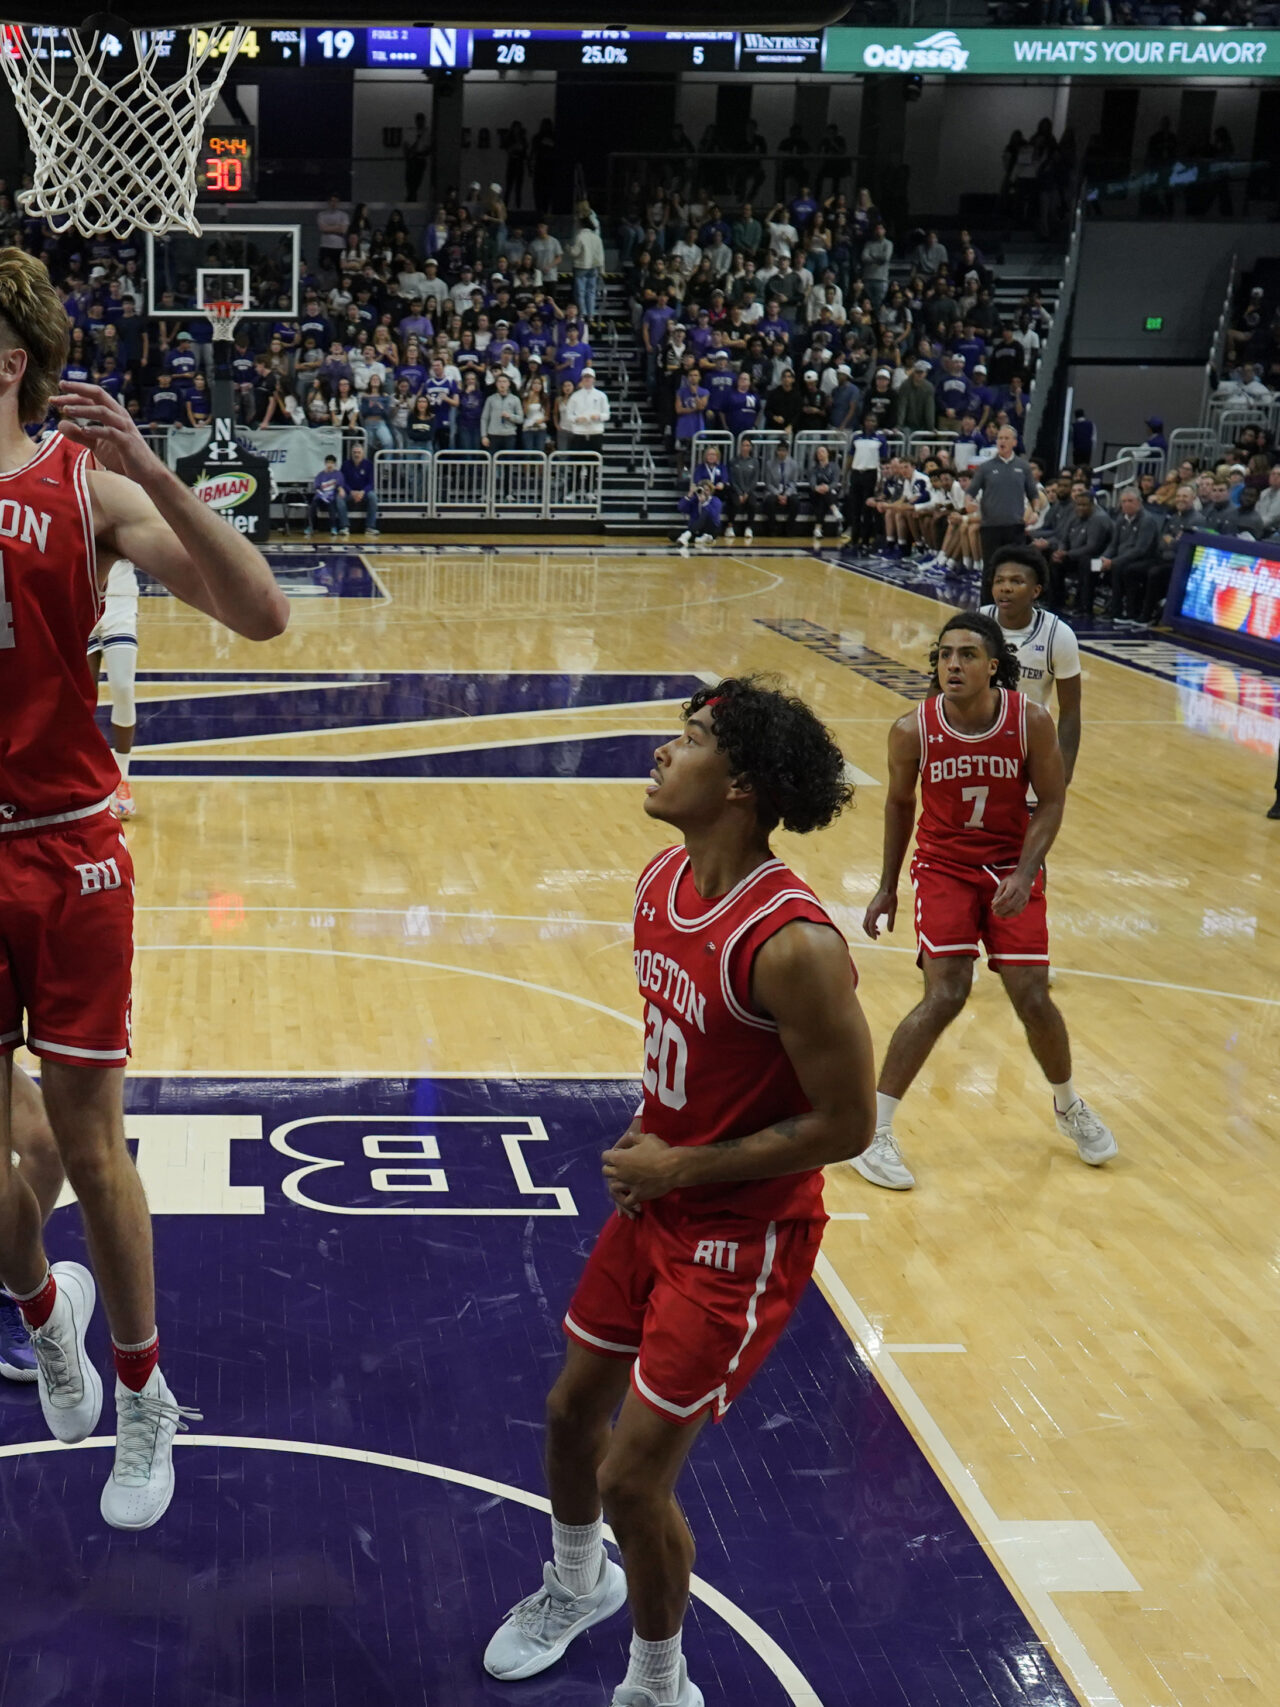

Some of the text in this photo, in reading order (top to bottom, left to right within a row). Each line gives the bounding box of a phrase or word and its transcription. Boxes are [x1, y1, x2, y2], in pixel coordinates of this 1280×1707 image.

[189, 30, 260, 58] 9:44
[317, 30, 355, 58] 19
[429, 28, 457, 67] N
[497, 44, 526, 64] 2/8
[582, 46, 628, 64] 25.0%
[693, 46, 705, 64] 5
[744, 33, 820, 49] WINTRUST
[1014, 40, 1267, 63] WHAT'S YOUR FLAVOR?
[863, 44, 968, 71] Odyssey
[209, 137, 247, 155] 9:44
[206, 158, 242, 192] 30
[215, 418, 232, 441] N
[194, 478, 250, 504] IBMAN
[930, 755, 1019, 784] BOSTON
[961, 785, 990, 829] 7
[74, 858, 122, 897] BU
[634, 949, 707, 1035] BOSTON
[642, 1002, 688, 1111] 20
[694, 1239, 739, 1273] BU
